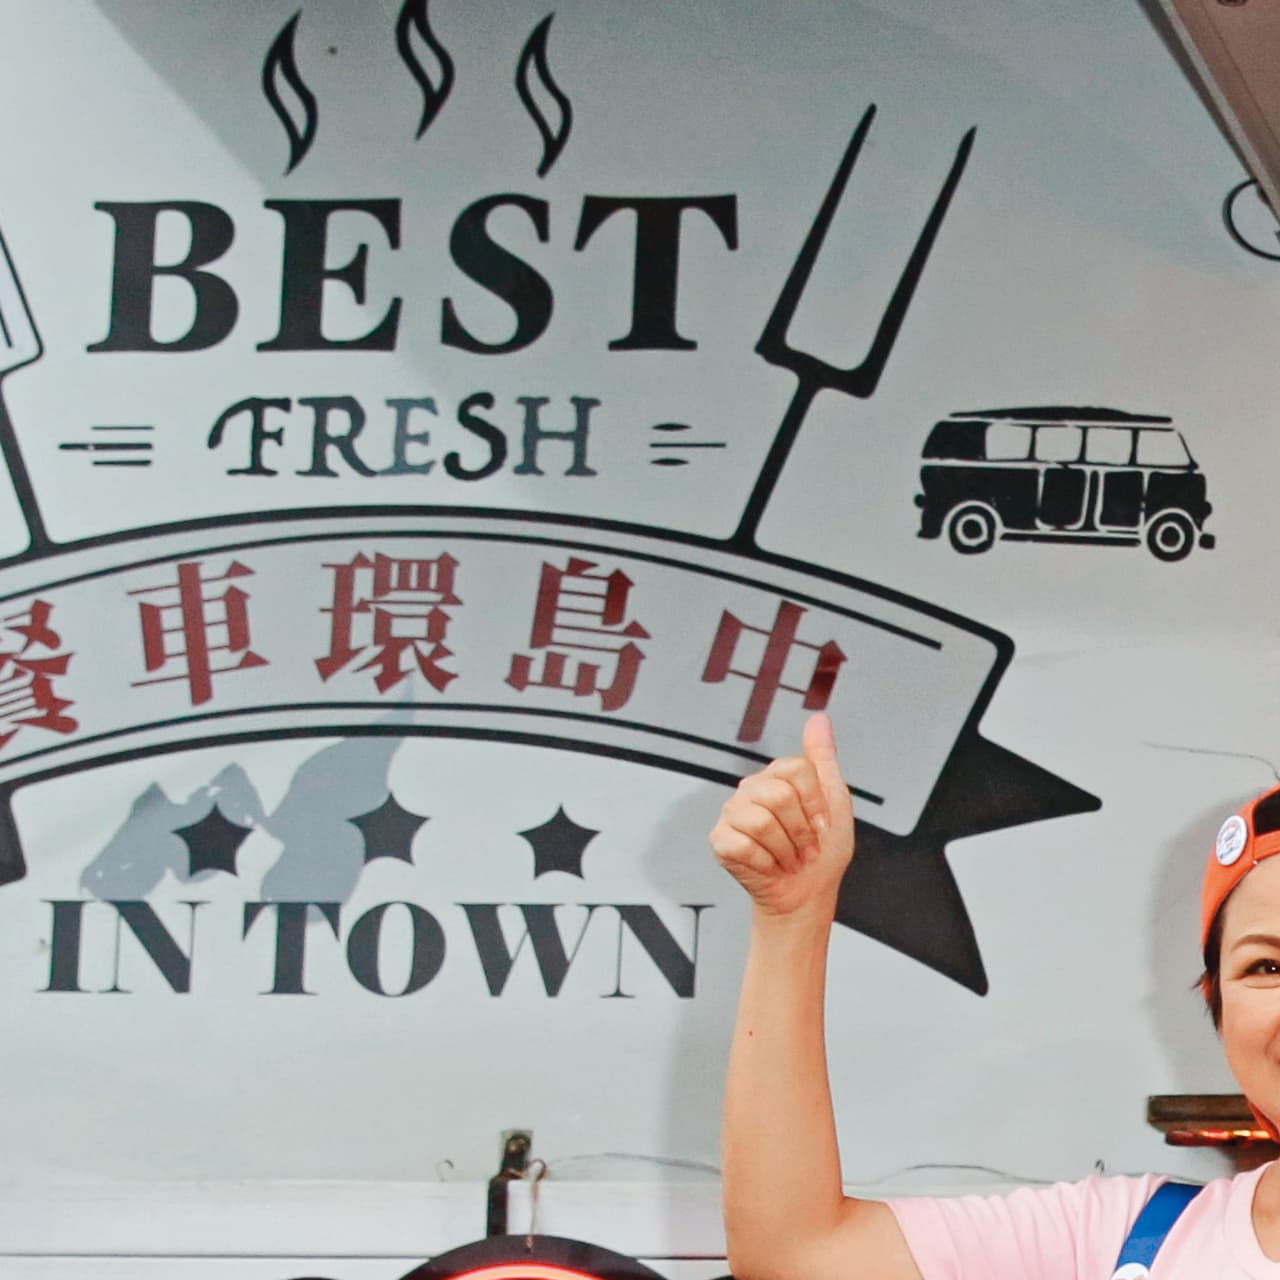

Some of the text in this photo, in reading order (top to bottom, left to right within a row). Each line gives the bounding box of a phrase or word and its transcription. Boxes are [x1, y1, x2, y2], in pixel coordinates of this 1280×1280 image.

[85, 192, 740, 356] BEST
[207, 391, 601, 482] FRESH
[37, 899, 716, 998] IN TOWN
